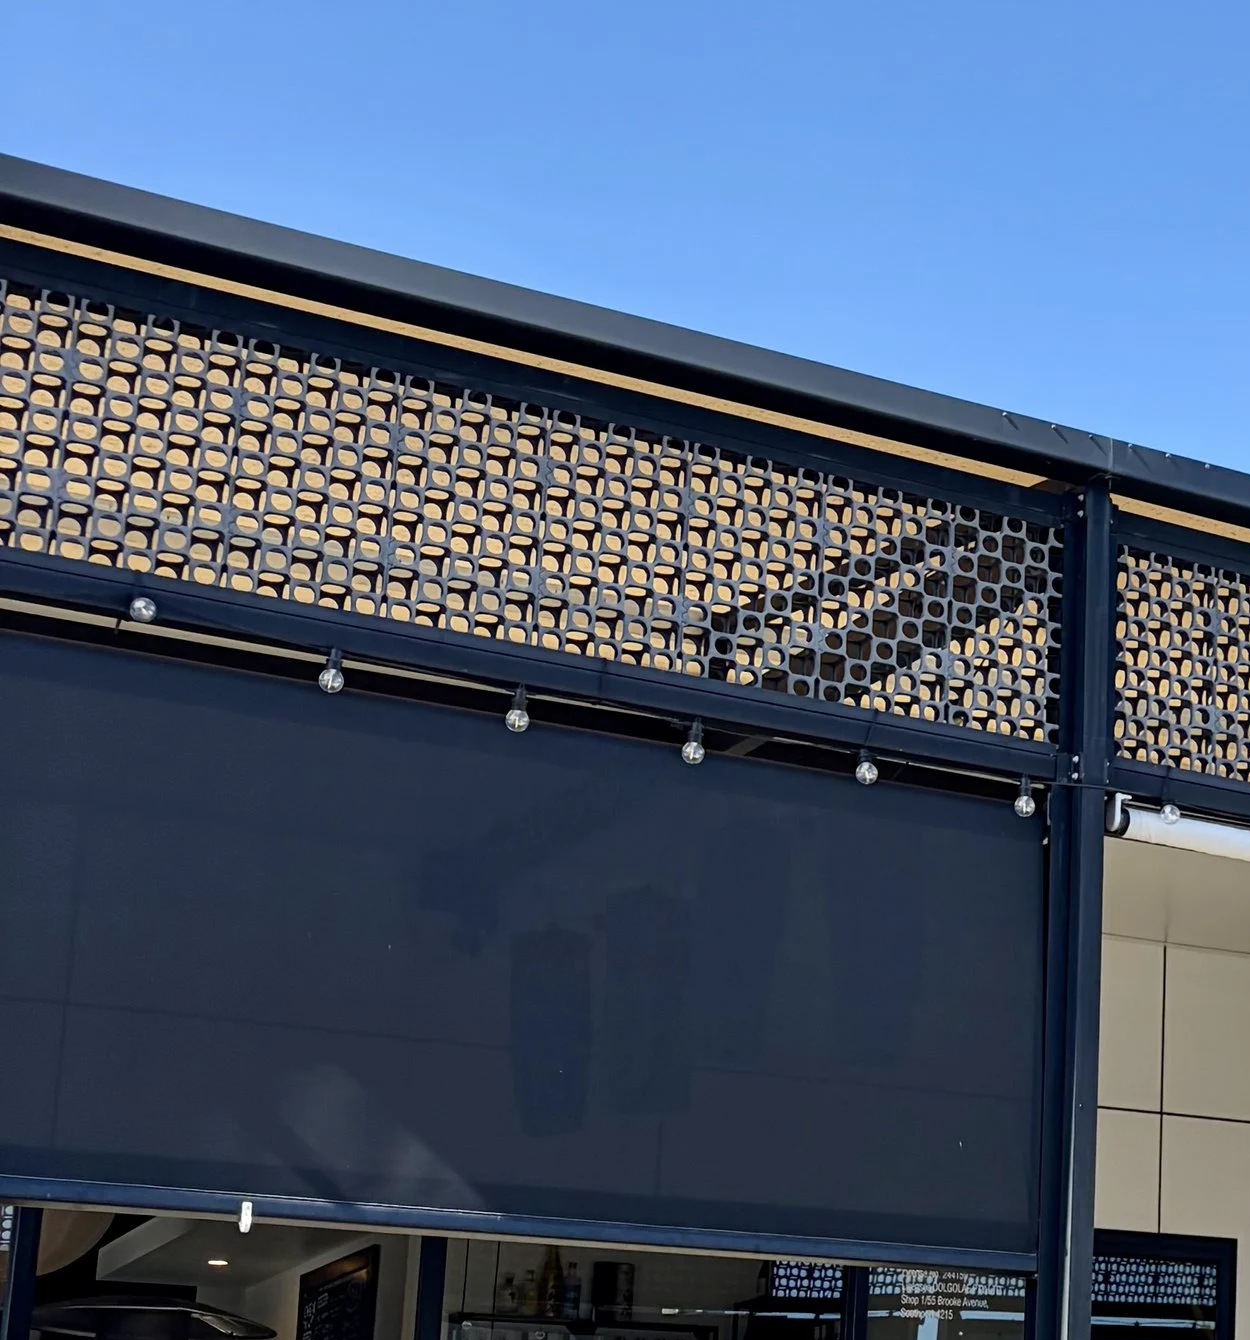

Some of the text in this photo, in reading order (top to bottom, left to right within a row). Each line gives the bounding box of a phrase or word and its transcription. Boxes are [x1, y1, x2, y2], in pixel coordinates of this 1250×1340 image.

[901, 1295, 919, 1306] Shop
[921, 1295, 936, 1306] 1/55
[937, 1296, 961, 1307] Brooke
